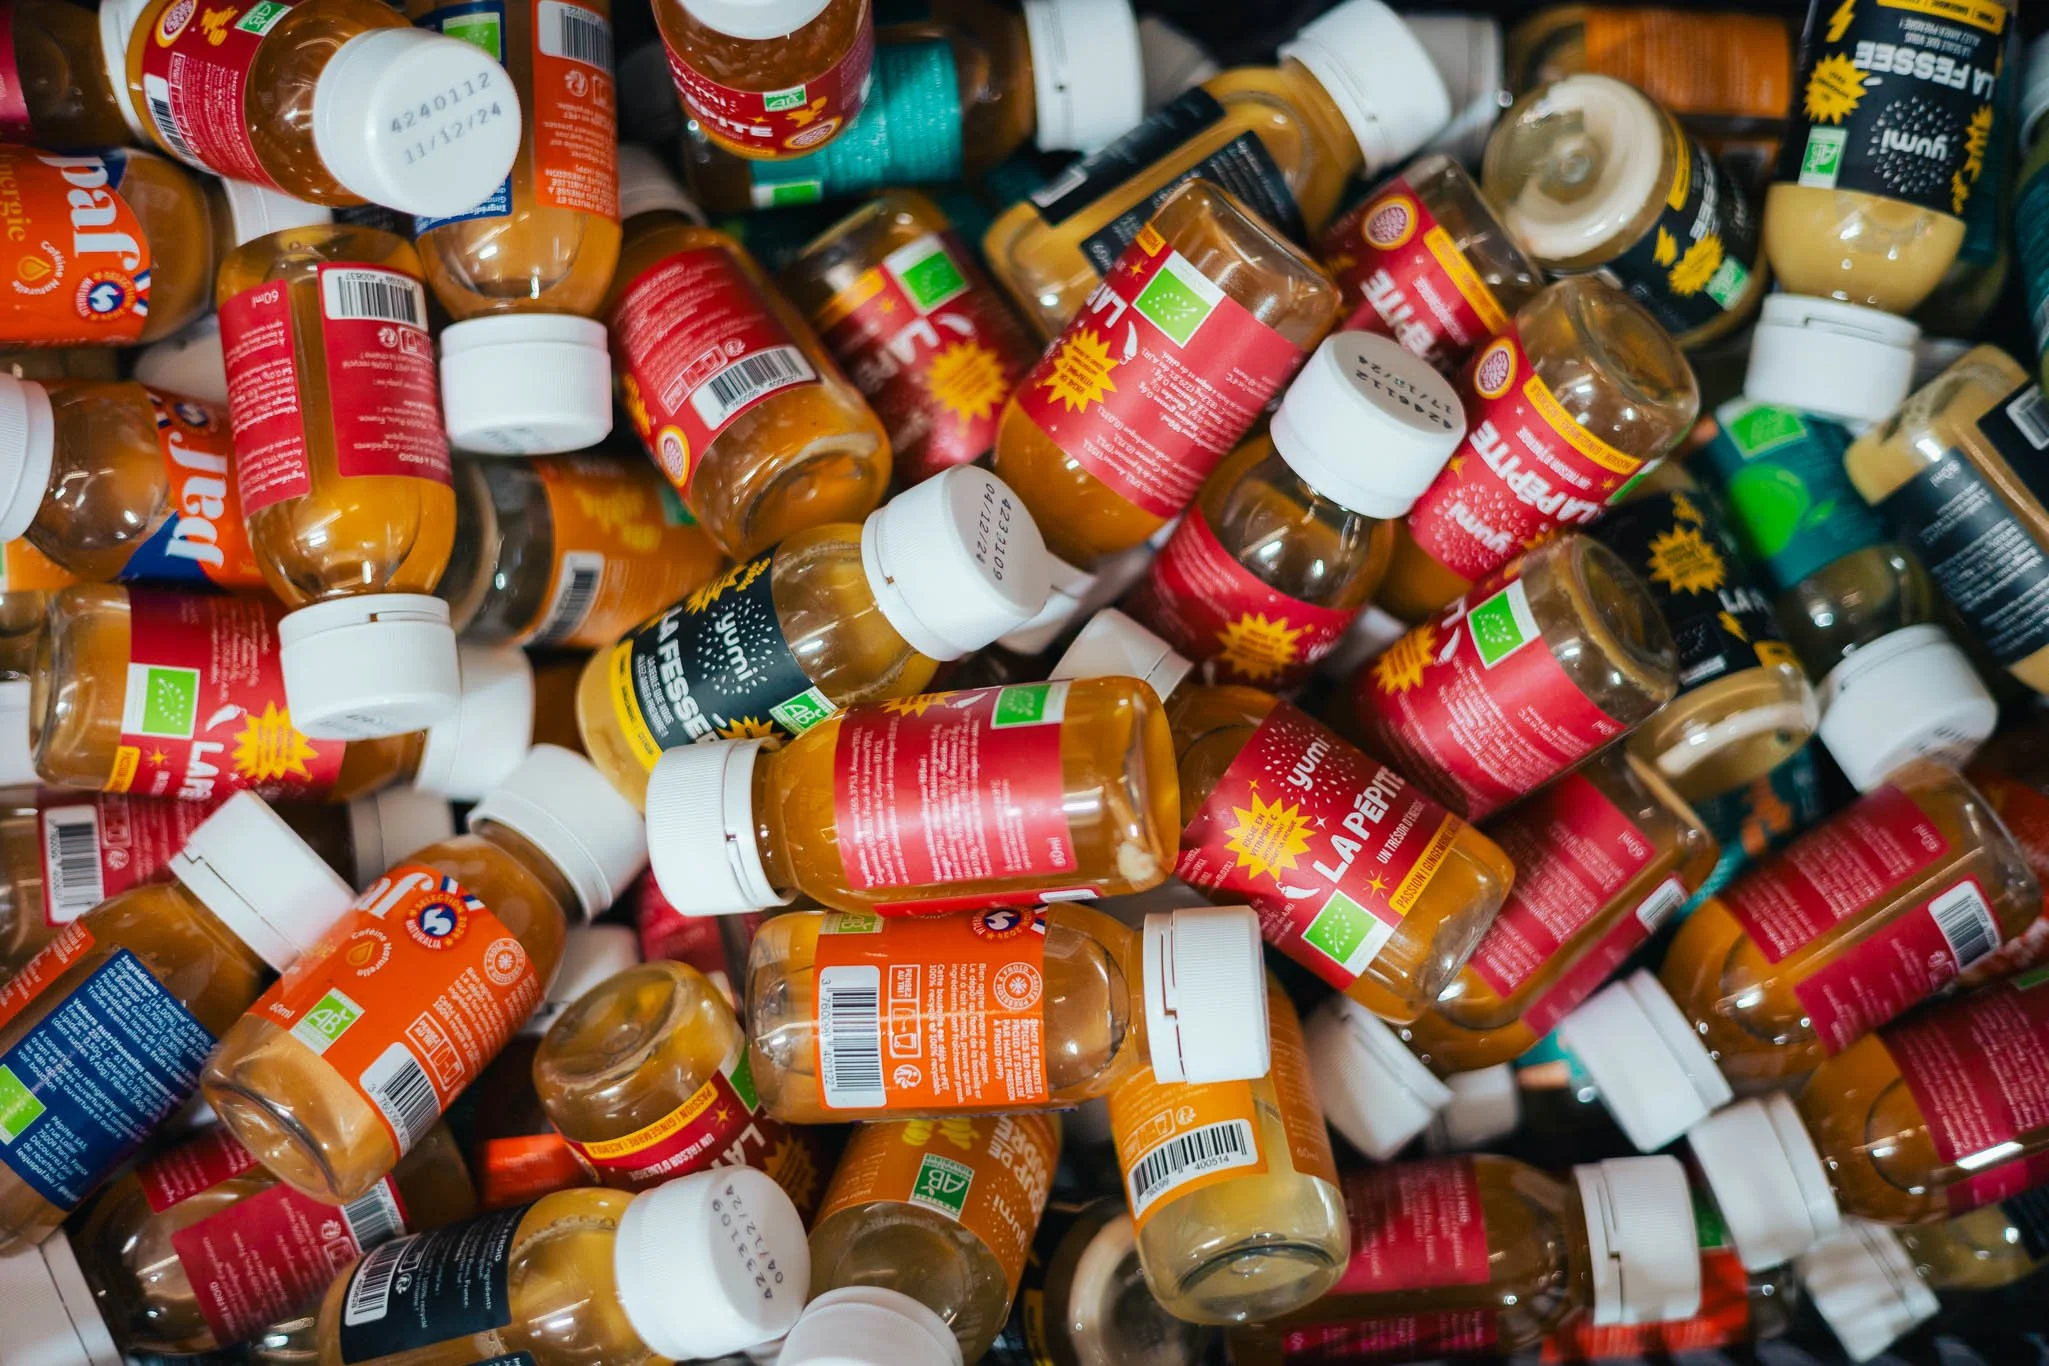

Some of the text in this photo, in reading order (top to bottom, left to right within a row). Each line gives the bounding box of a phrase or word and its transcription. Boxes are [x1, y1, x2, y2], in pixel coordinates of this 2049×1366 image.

[1850, 38, 1997, 100] LA FESSÉE
[389, 71, 493, 137] 4240112
[402, 103, 504, 165] 11/12/24
[1877, 127, 1949, 162] yumi
[35, 155, 141, 271] paf
[10, 239, 65, 295] Caféine Naturelle
[249, 288, 280, 309] 60ml
[1090, 288, 1129, 329] LA
[1471, 423, 1601, 536] LA PÉPITE
[162, 430, 229, 569] paf
[974, 481, 998, 568] 04/12/24
[990, 497, 1014, 582] 4233109
[1442, 497, 1514, 556] yumi
[651, 604, 691, 644] LA
[715, 612, 758, 683] yumi
[645, 664, 663, 690] SEULE
[183, 740, 225, 779] LA
[1286, 738, 1329, 791] yumi
[1241, 812, 1266, 848] RICHE EN
[1249, 821, 1274, 857] VITAMINE
[1310, 769, 1403, 884] LA PÉPITE
[1374, 846, 1393, 866] UN
[1384, 823, 1409, 852] TRÉSOR
[1051, 835, 1066, 866] 60ml
[1396, 871, 1427, 908] PASSION
[96, 972, 123, 998] Poudre
[117, 953, 163, 997] Ingrédients
[820, 977, 831, 985] 3
[903, 967, 913, 997] PENSEZ
[927, 963, 936, 987] 100%
[935, 963, 945, 986] Cette
[948, 962, 960, 1011] ingrédients
[958, 963, 968, 980] tout
[977, 961, 986, 979] Bien
[926, 987, 937, 1021] recyclé
[935, 987, 946, 1027] bouteille
[959, 990, 968, 1006] fait
[975, 982, 986, 1010] agiter
[87, 984, 144, 1045] Traces éventuelles
[950, 1013, 959, 1032] sont
[966, 974, 981, 1089] dépôt fond bouteille
[1001, 1018, 1010, 1038] PAR
[55, 1010, 128, 1082] Lipides Saturés
[66, 1032, 92, 1058] sucres
[69, 997, 148, 1074] Valeurs nutritionnelles
[927, 1033, 938, 1057] 100%
[992, 1028, 1001, 1056] FROID
[1010, 1018, 1020, 1048] FROID
[17, 1049, 60, 1093] voir bouchon
[30, 1036, 75, 1084] avant après
[822, 1049, 835, 1086] 401122
[936, 1044, 947, 1062] déjà
[959, 1041, 969, 1070] preuve
[1003, 1039, 1012, 1067] HAUTE
[40, 1063, 95, 1115] après ouverture
[43, 1036, 121, 1113] conserver réfrigérateur
[673, 1087, 716, 1118] PASSION
[36, 1128, 58, 1148] 75009
[50, 1115, 74, 1139] Pépites
[626, 1114, 678, 1151] GINGEMBRE
[696, 1130, 716, 1149] UN
[29, 1134, 63, 1166] Découvrez
[31, 1150, 57, 1174] recettes
[667, 1141, 703, 1169] TRÉSOR
[1192, 1154, 1230, 1170] 400514
[931, 1169, 966, 1194] AB
[711, 1196, 775, 1301] 4233109
[725, 1181, 785, 1285] 04/12/24
